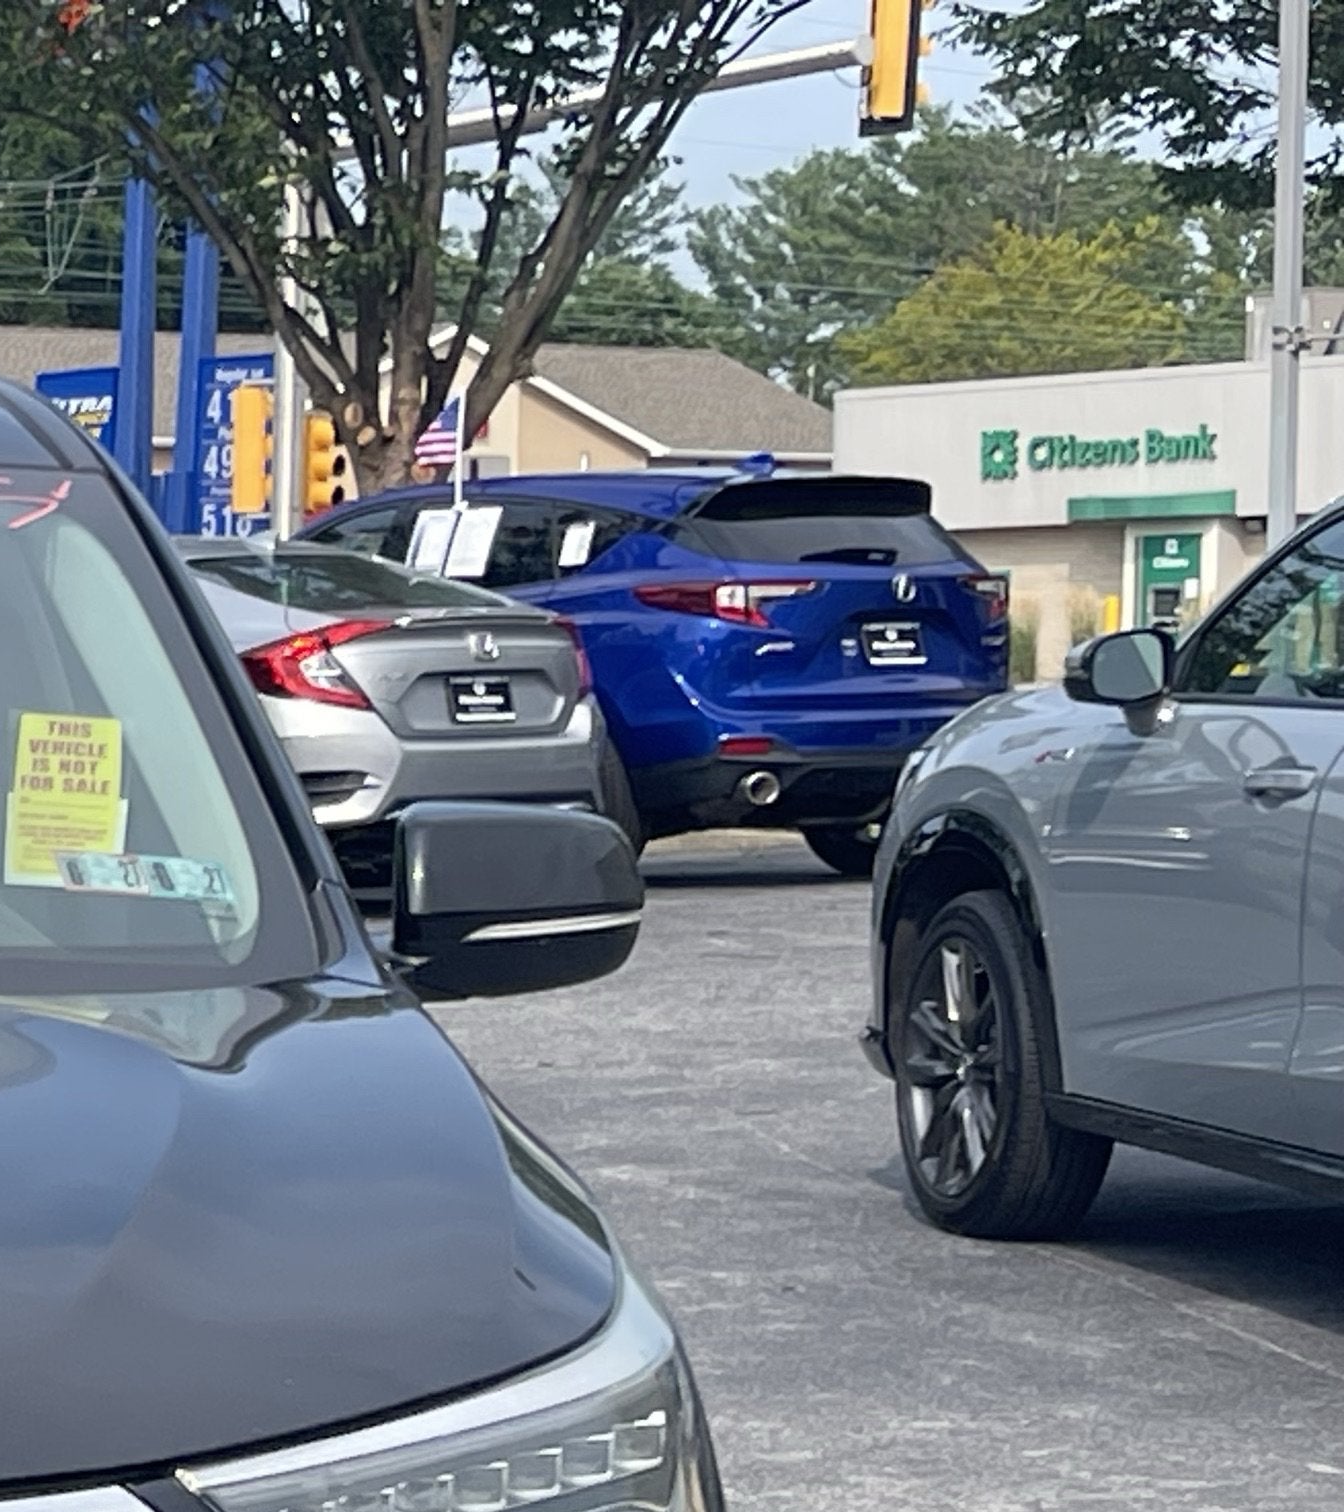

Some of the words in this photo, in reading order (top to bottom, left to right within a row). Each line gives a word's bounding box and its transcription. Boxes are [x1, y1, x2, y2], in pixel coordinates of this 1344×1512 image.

[1028, 435, 1140, 471] Citizens
[1144, 423, 1217, 464] Bank
[47, 720, 92, 738] THIS
[29, 738, 109, 758] VEHICLE
[32, 758, 51, 773] IS
[58, 758, 98, 775] NOT
[20, 775, 54, 791] FOR
[62, 777, 111, 795] SALE
